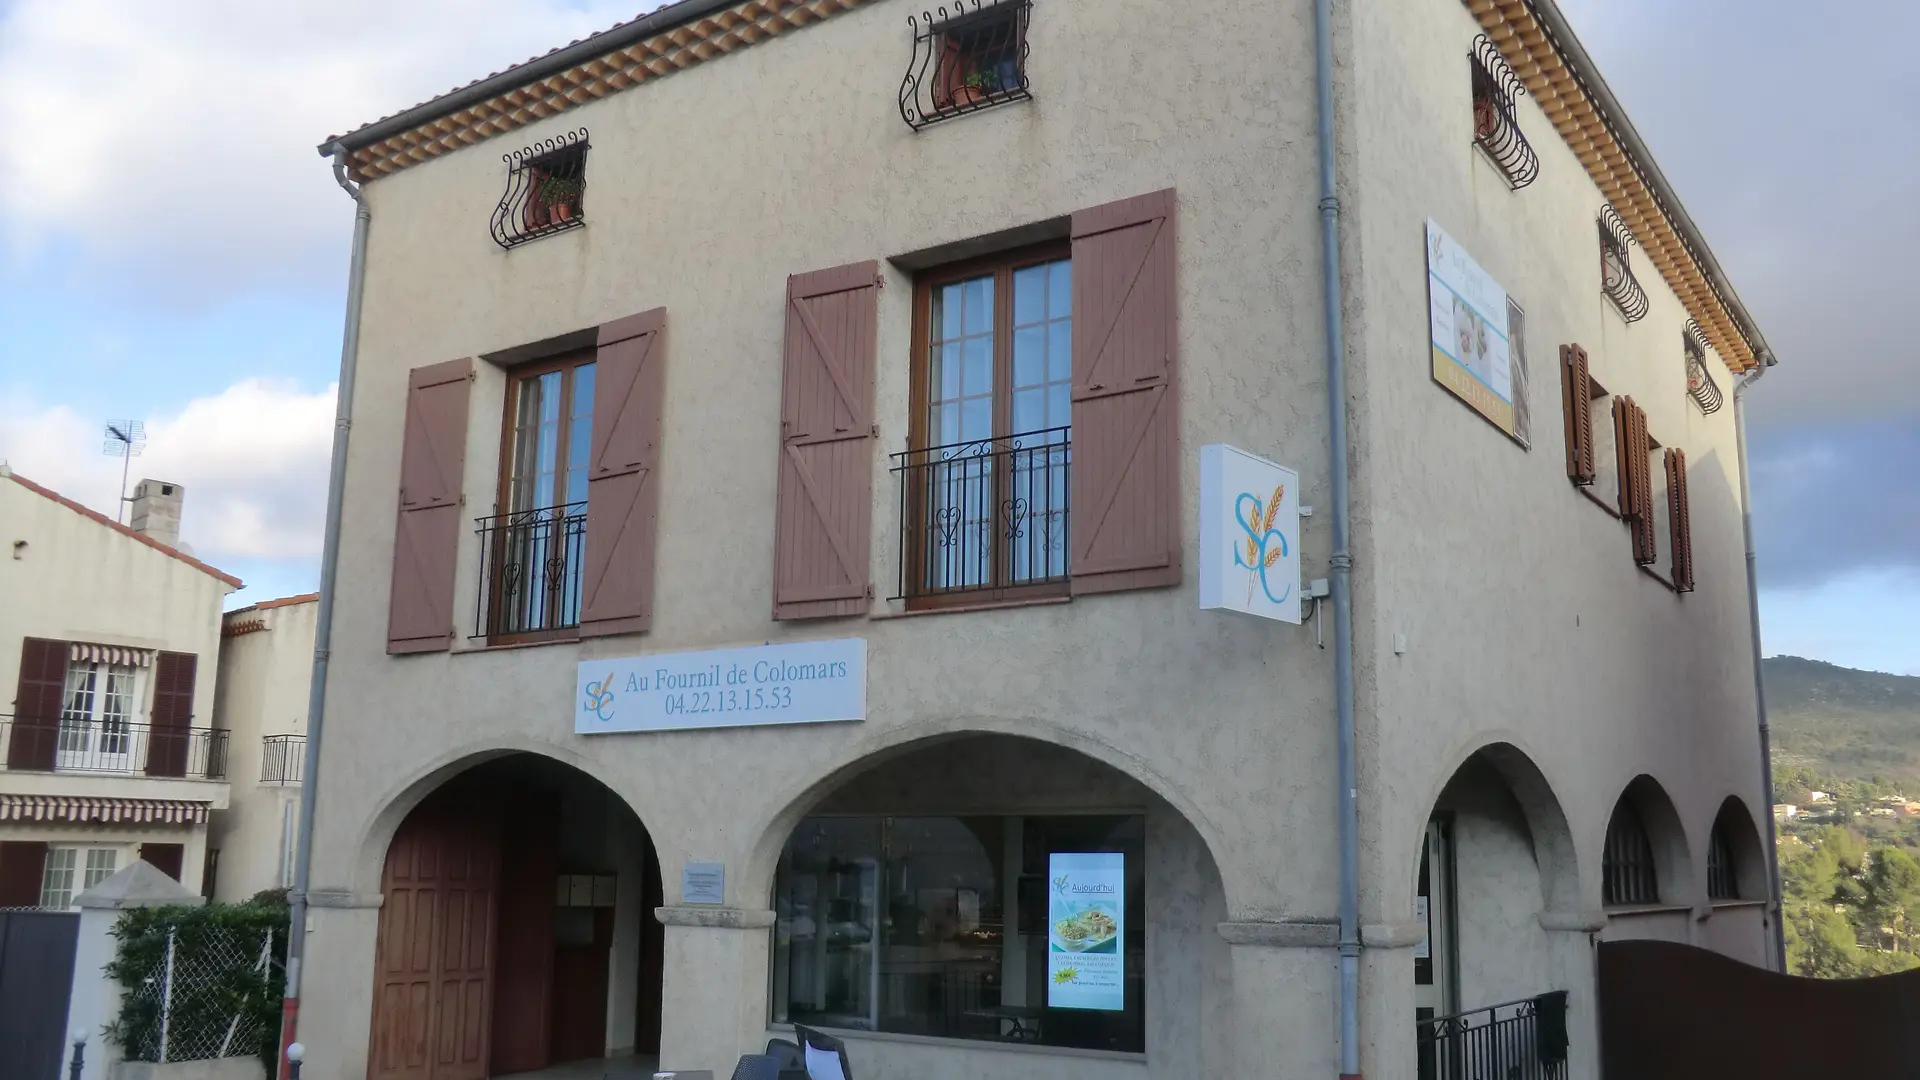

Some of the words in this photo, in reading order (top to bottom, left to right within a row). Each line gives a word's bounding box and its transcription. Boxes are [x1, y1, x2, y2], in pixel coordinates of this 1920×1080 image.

[625, 671, 649, 692] Au
[655, 664, 720, 691] Fournil
[726, 663, 748, 685] de
[753, 659, 847, 684] Colomars
[665, 686, 792, 715] 04.22.13.15.53
[1071, 883, 1116, 893] Aujourd'hui
